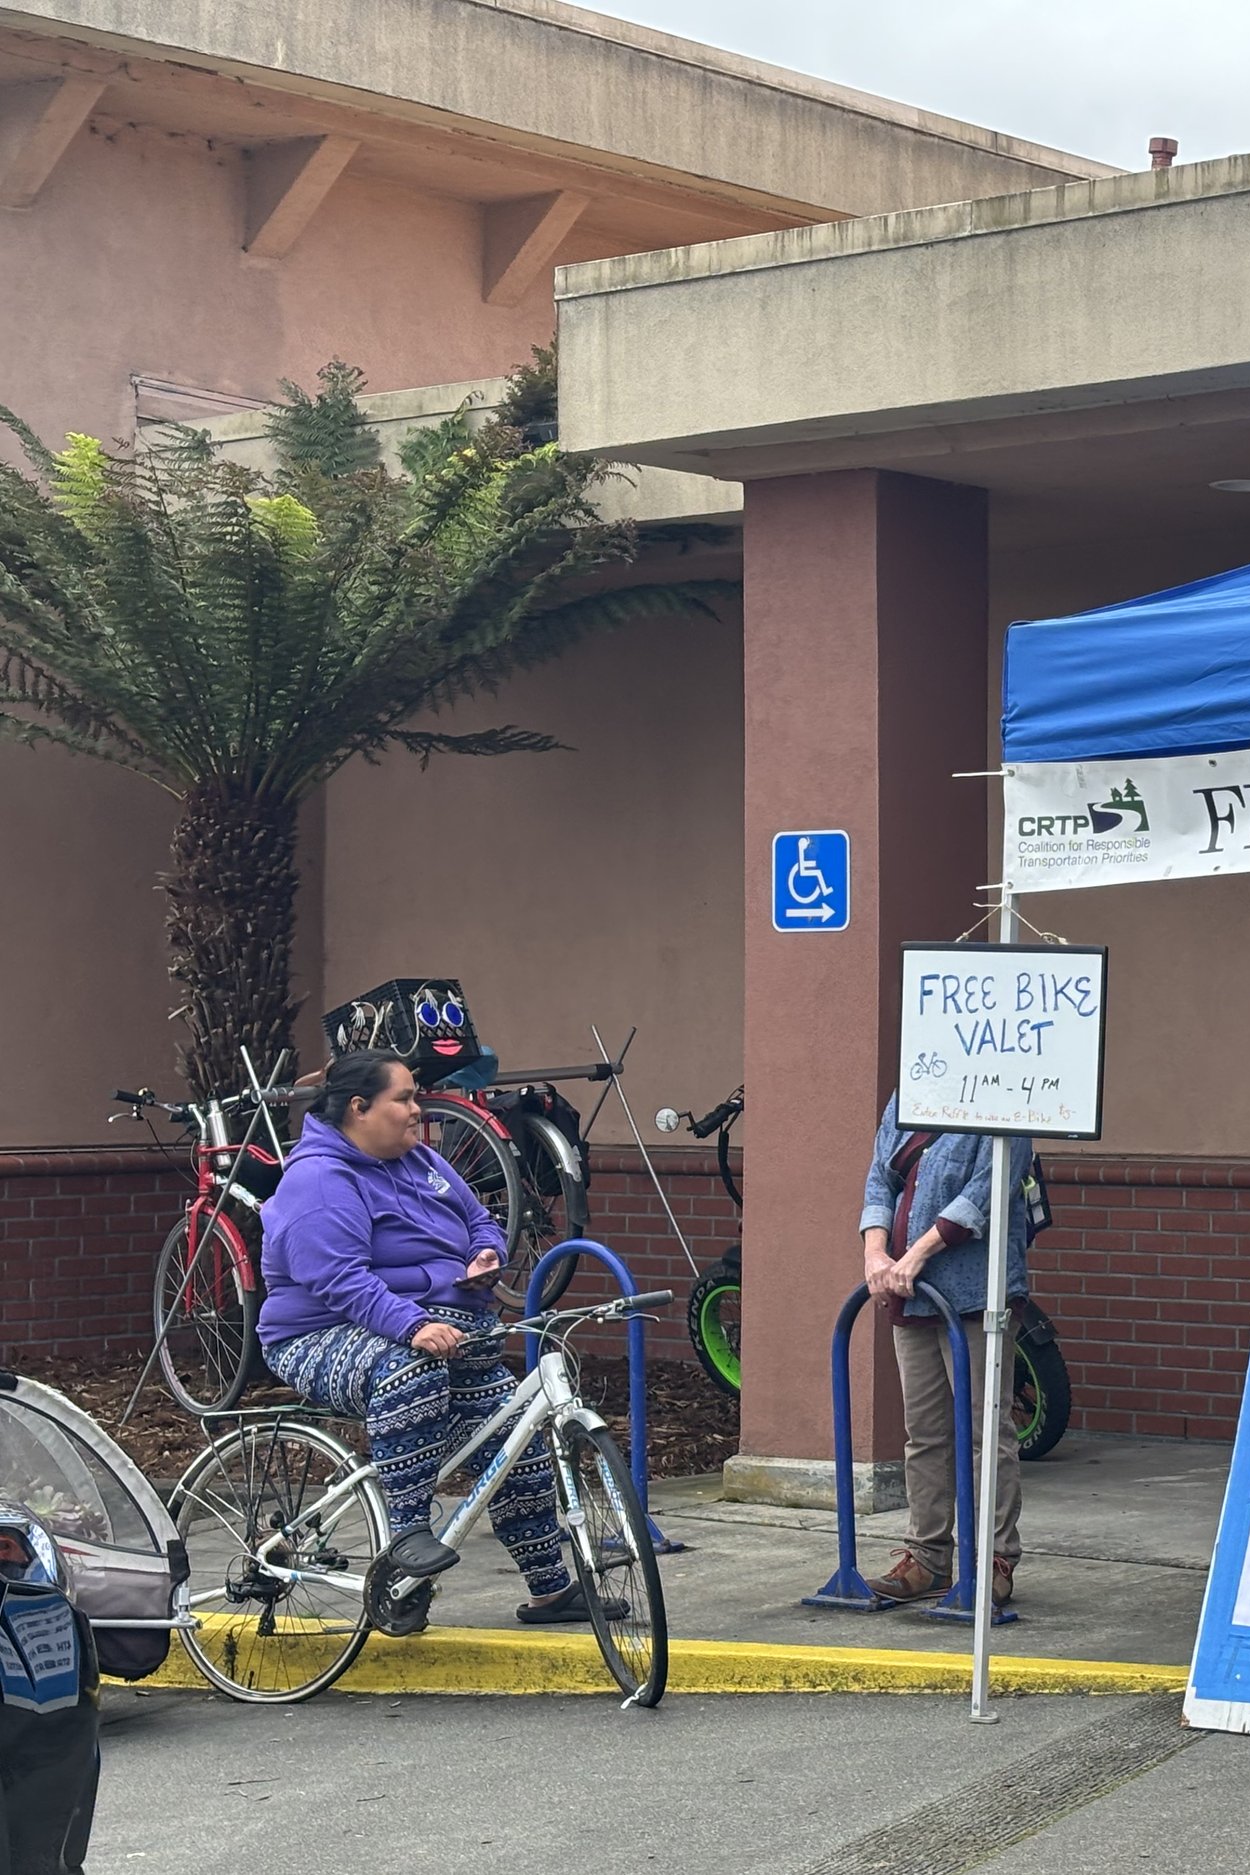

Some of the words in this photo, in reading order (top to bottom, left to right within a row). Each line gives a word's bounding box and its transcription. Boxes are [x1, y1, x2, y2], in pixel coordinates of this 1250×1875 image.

[1018, 815, 1089, 836] CRTP
[1018, 841, 1065, 854] Coalition
[1068, 839, 1083, 852] for
[1086, 837, 1151, 854] Responsible
[1017, 853, 1098, 869] Transportation
[1101, 852, 1149, 865] Priorities
[920, 974, 997, 1015] FREE
[1015, 972, 1098, 1017] BIKE
[954, 1018, 1054, 1056] VALET
[690, 1279, 716, 1350] KENDA
